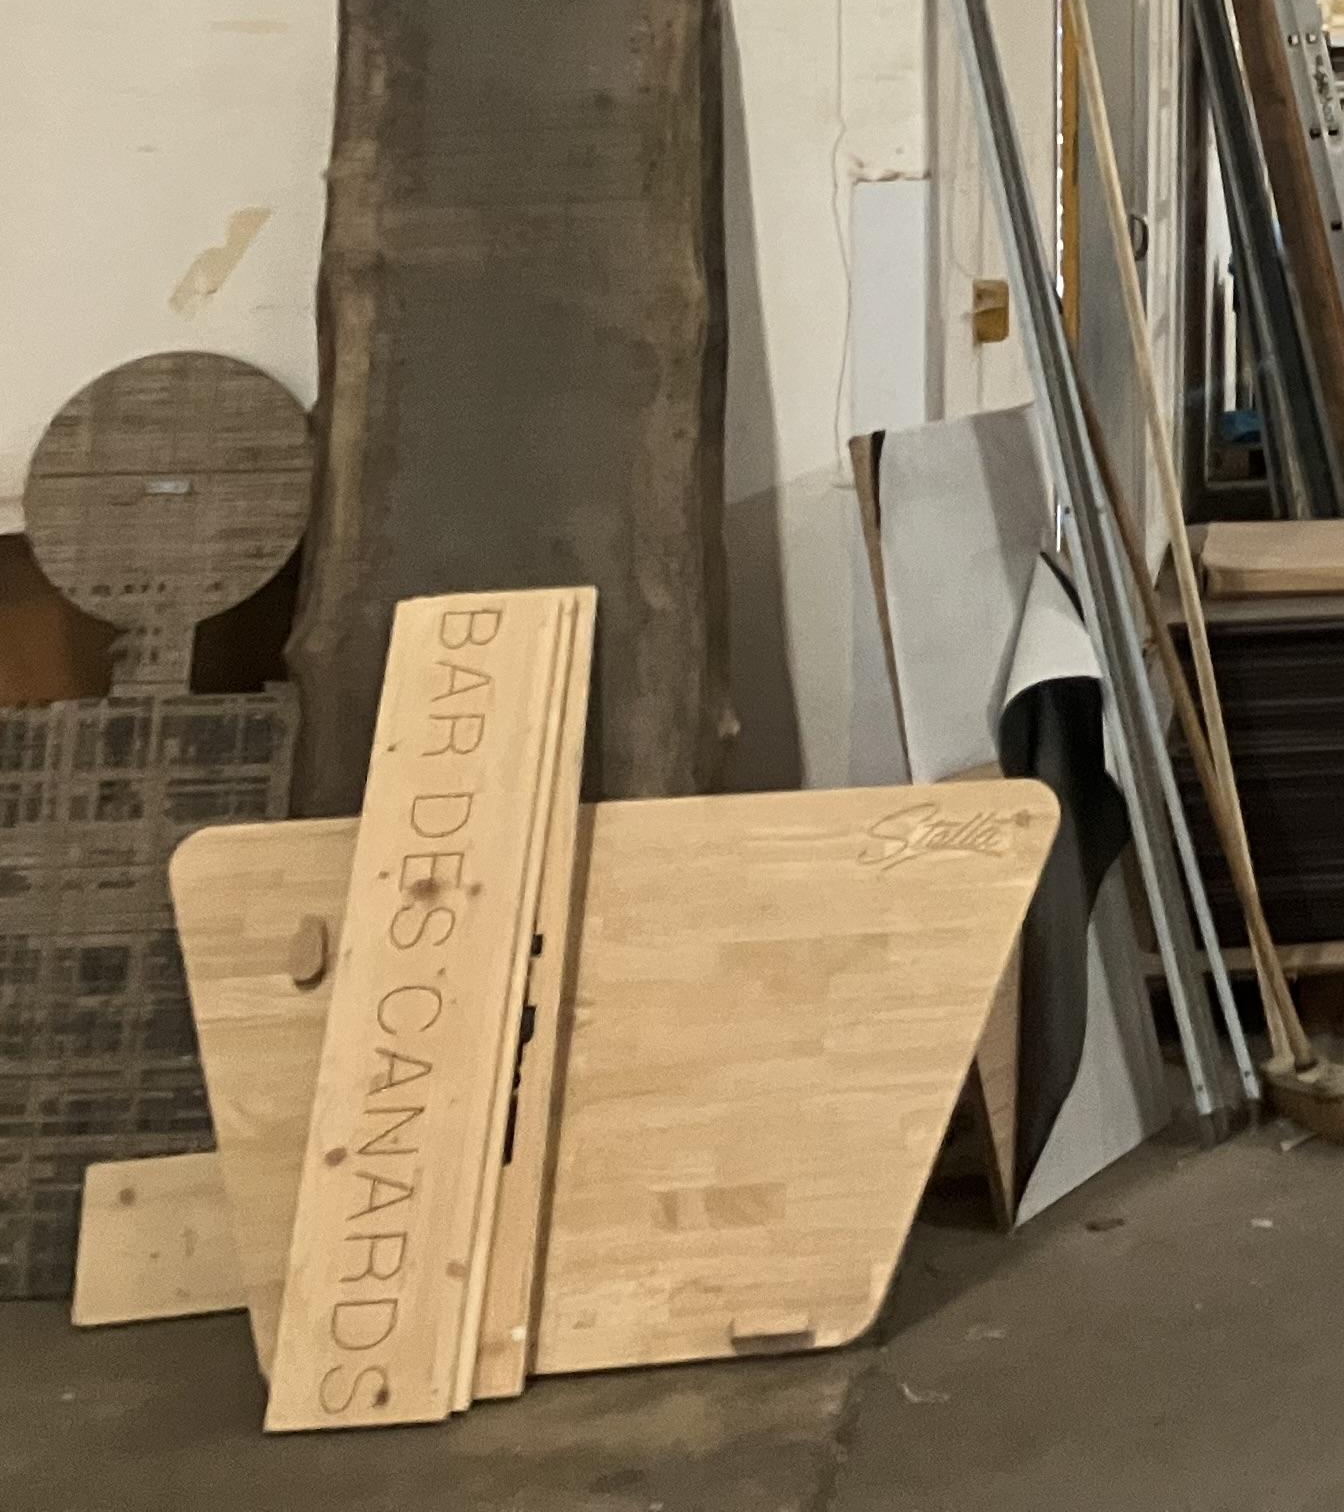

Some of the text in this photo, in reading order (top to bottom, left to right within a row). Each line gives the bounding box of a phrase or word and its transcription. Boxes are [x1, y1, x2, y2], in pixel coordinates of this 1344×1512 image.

[318, 607, 501, 1415] BAR DES CANARDS
